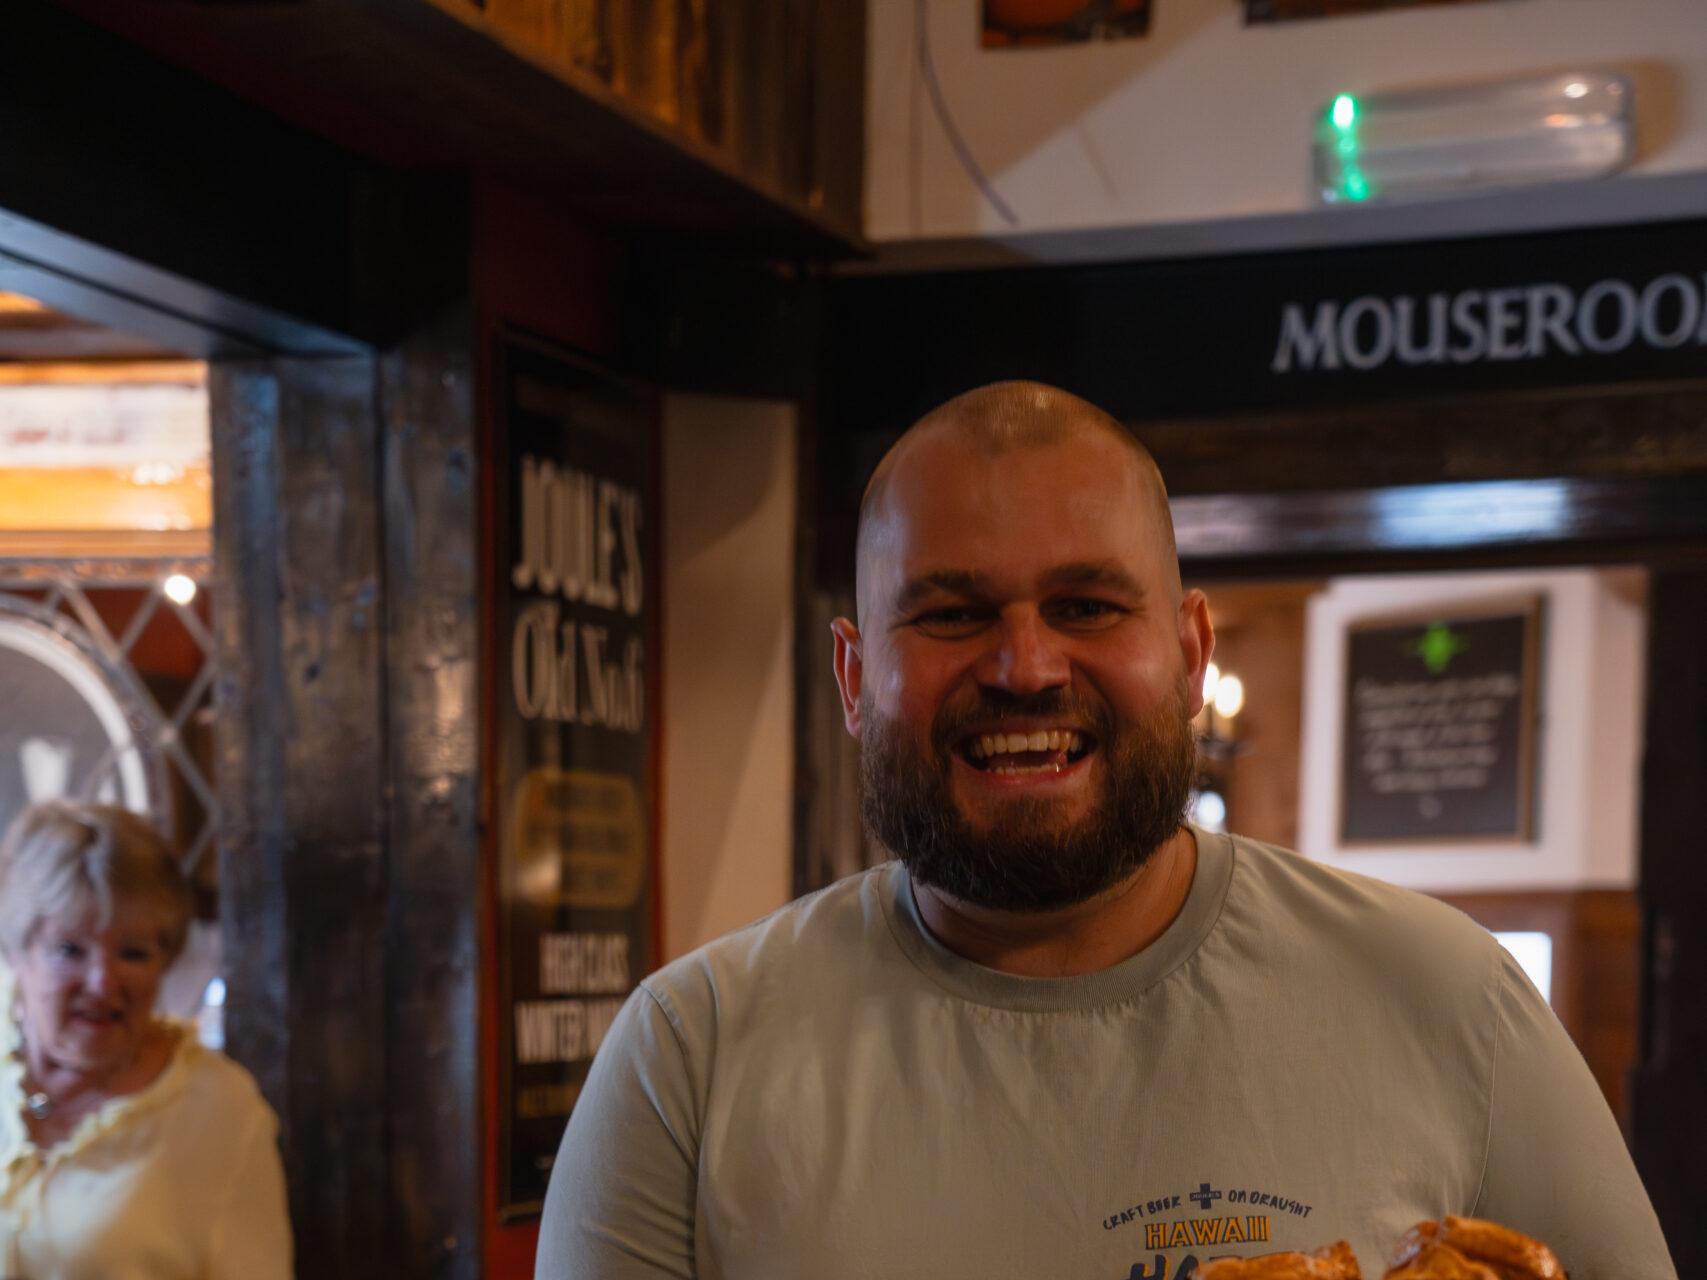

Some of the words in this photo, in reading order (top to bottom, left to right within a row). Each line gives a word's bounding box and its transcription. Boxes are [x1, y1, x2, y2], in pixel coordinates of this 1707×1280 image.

[1271, 273, 1707, 374] MOUSEROO
[1103, 1204, 1145, 1230] CRAFT
[1147, 1196, 1181, 1215] BEER
[1250, 1191, 1312, 1219] DRAUGHT
[1144, 1216, 1270, 1250] HAWAII
